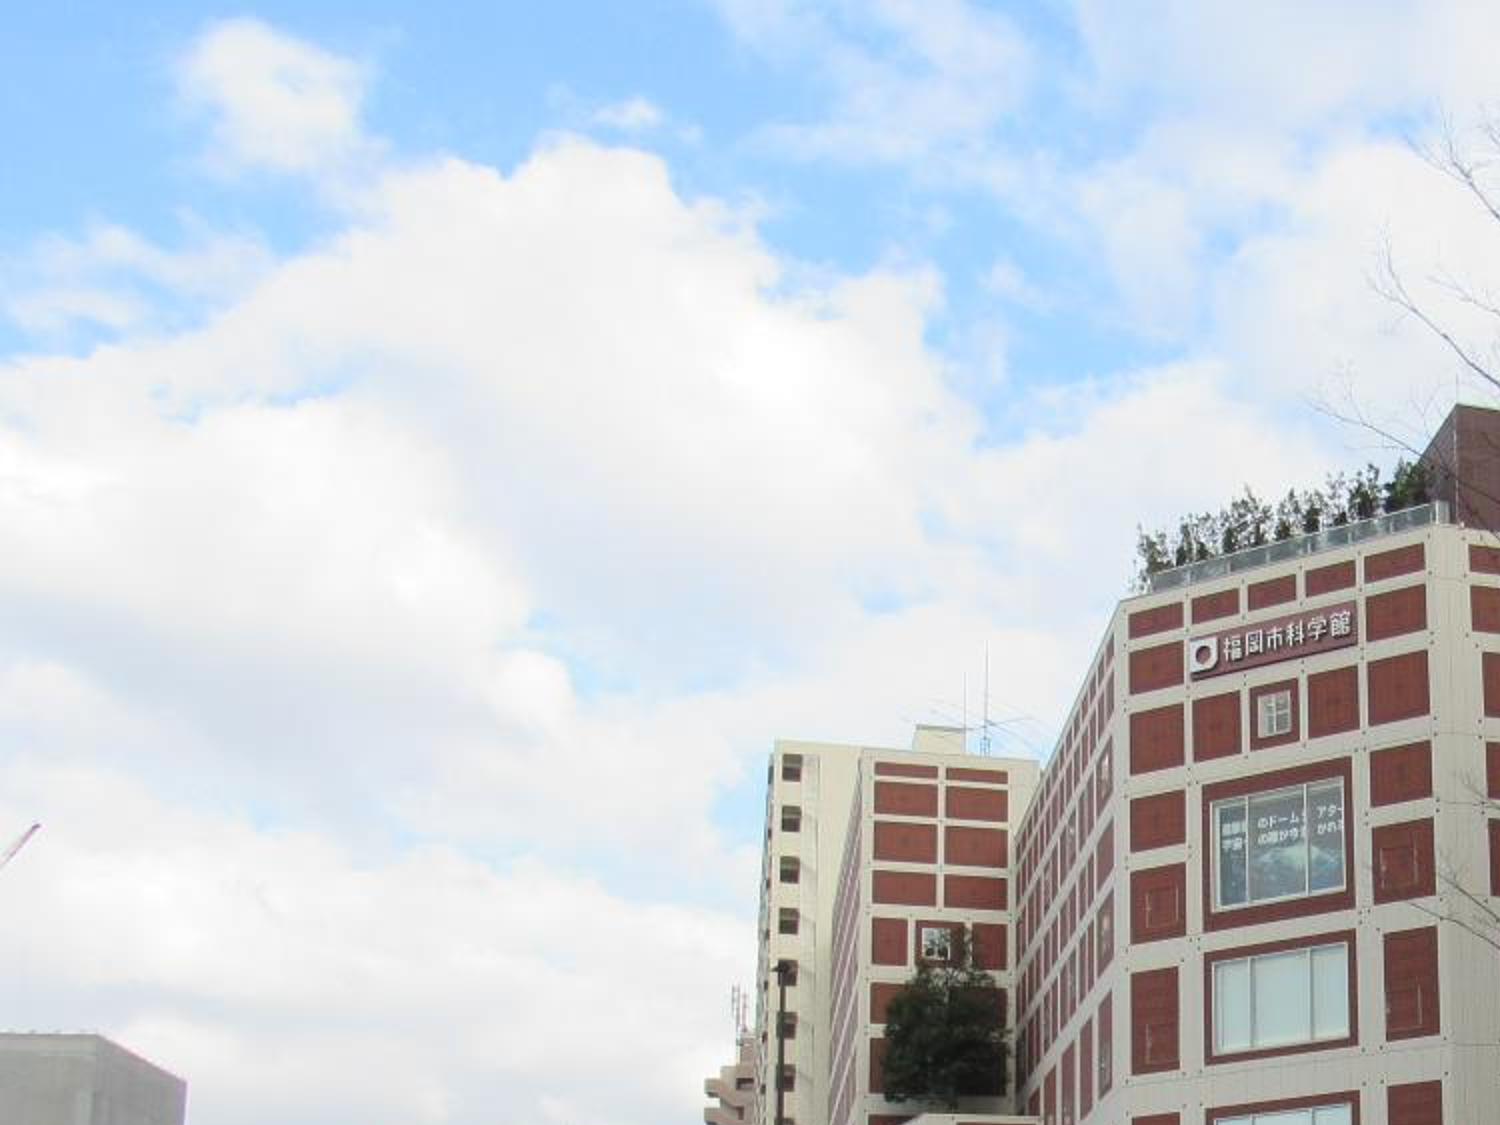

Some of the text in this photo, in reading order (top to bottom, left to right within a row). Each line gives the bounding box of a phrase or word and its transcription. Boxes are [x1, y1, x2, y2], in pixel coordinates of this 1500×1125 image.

[1223, 610, 1351, 662] 福岡市科学館
